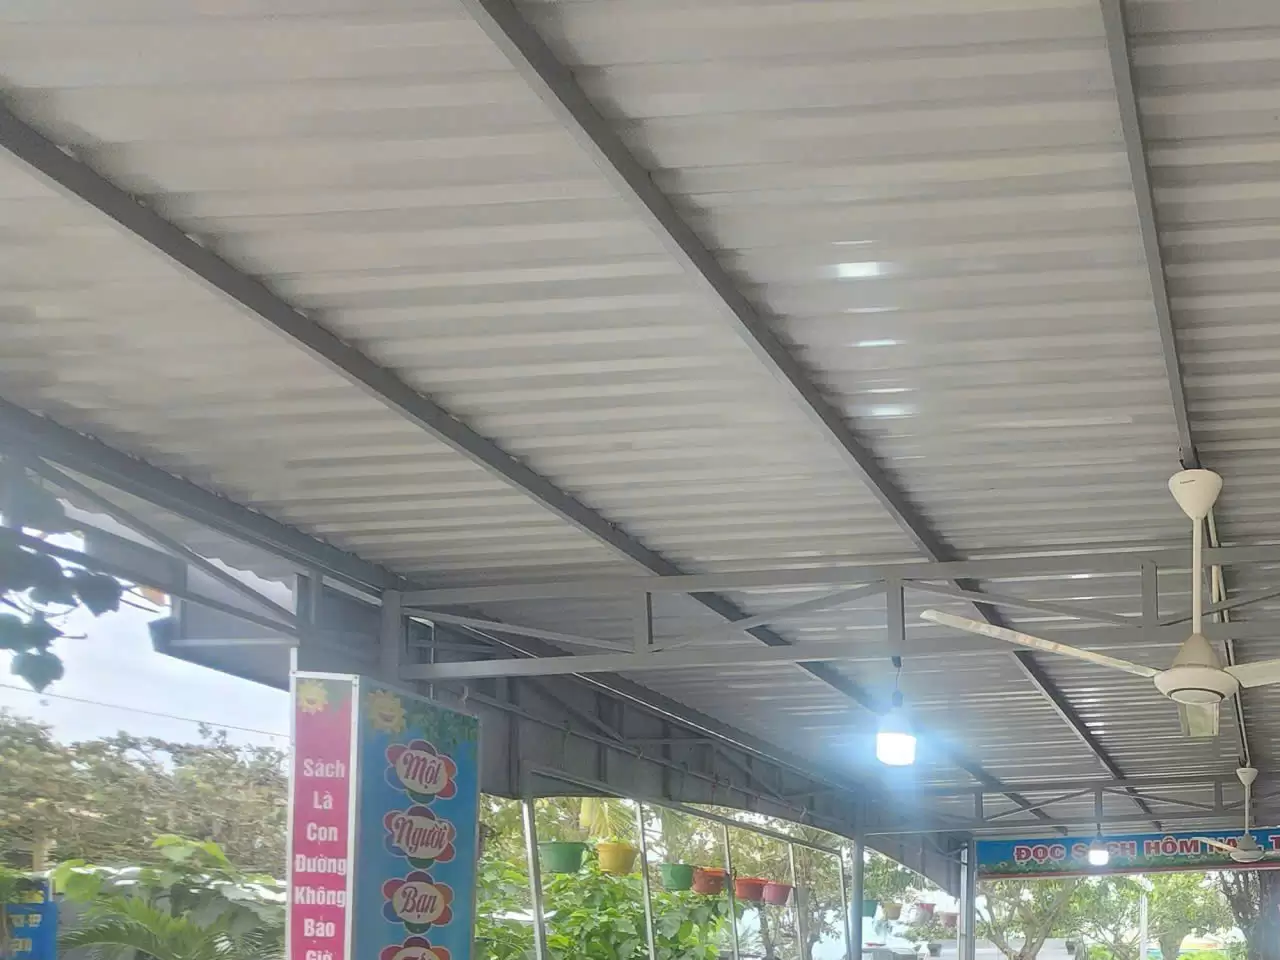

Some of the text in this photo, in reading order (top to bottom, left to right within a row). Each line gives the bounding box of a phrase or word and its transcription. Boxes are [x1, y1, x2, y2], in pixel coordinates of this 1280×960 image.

[303, 758, 346, 778] Sách
[313, 791, 334, 810] Là
[1014, 844, 1066, 864] ĐỌC
[1144, 835, 1200, 857] HÔM
[294, 885, 346, 908] Không
[401, 886, 438, 918] Bạn
